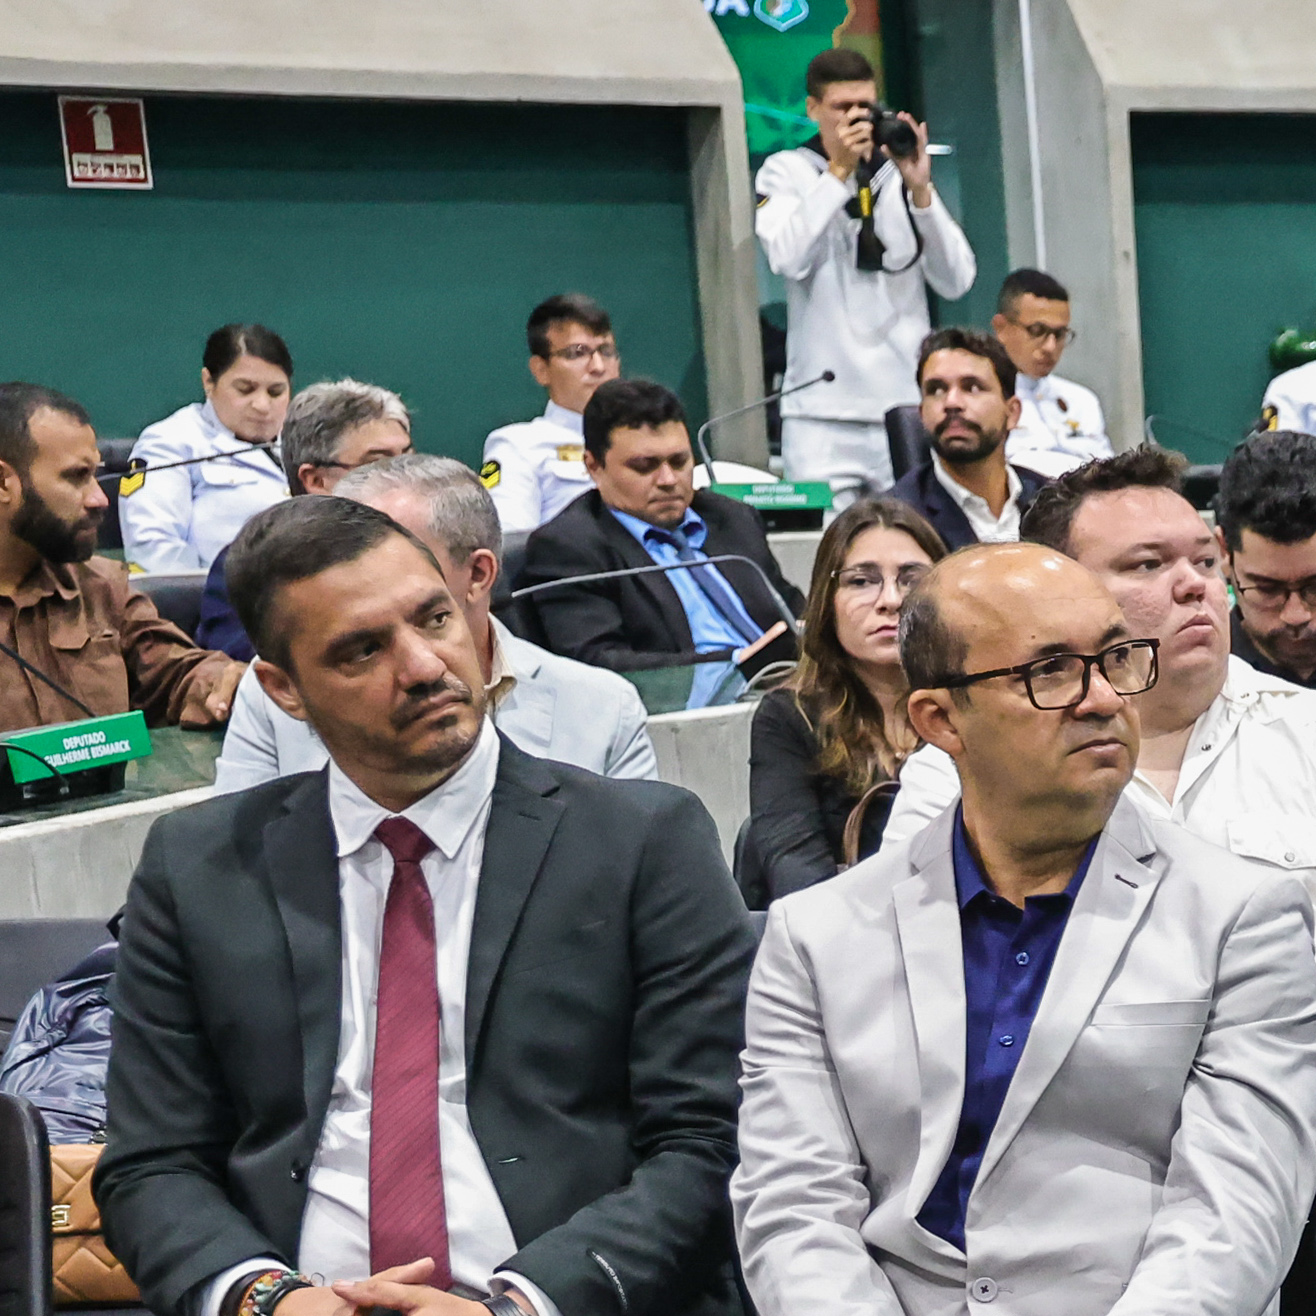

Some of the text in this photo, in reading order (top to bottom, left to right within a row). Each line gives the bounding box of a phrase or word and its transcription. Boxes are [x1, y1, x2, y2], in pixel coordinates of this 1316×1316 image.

[62, 731, 106, 750] DEPUTADO
[44, 739, 131, 767] GUILHERME BISMARCK
